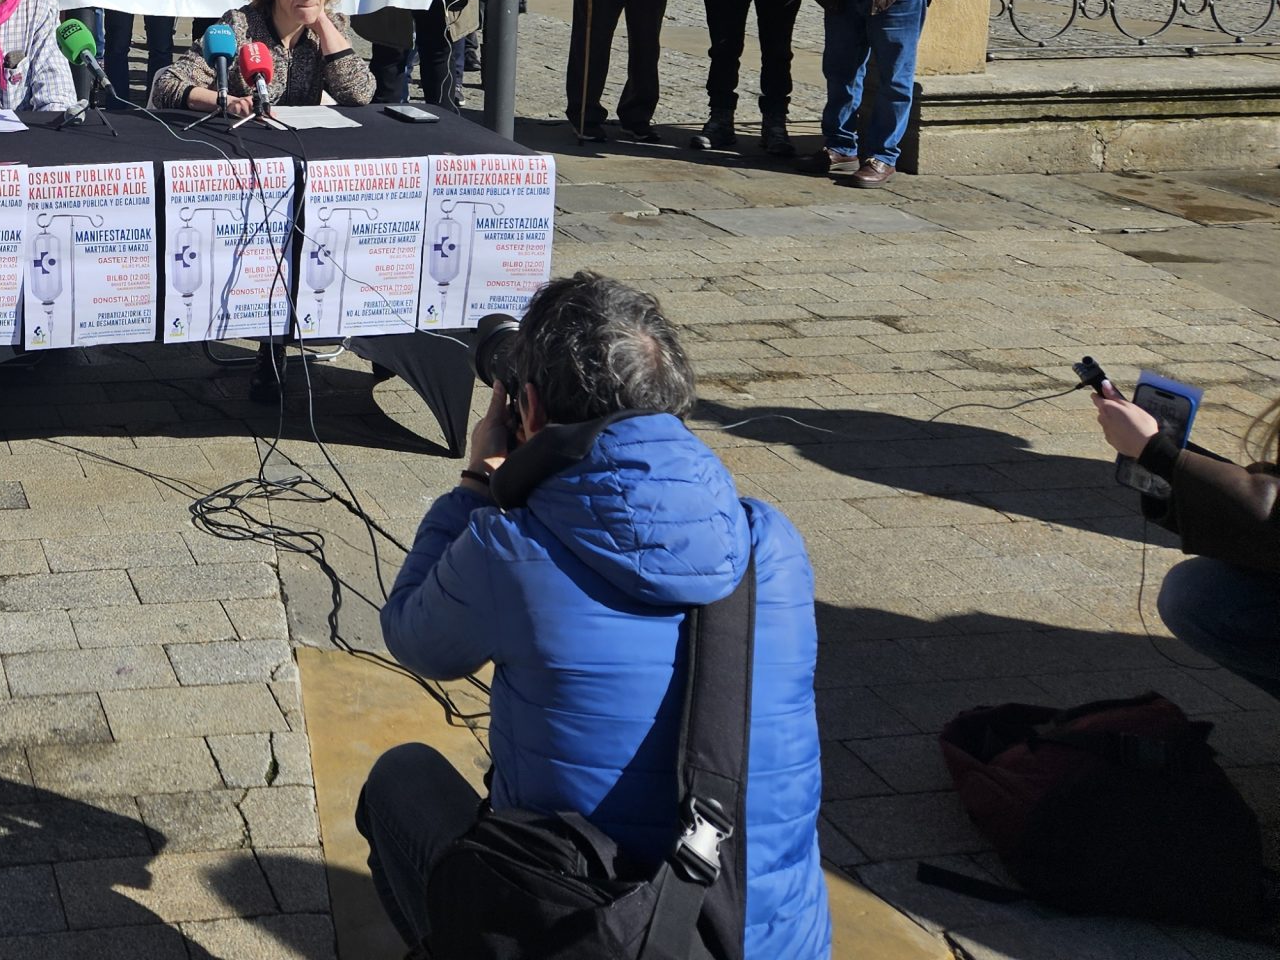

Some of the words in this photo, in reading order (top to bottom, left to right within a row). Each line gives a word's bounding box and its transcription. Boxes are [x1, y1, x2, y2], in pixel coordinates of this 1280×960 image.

[172, 165, 212, 178] OSASUN
[267, 162, 285, 174] ETA
[310, 165, 350, 178] OSASUN
[355, 163, 397, 176] PUBLIKO
[403, 162, 420, 174] ETA
[436, 159, 476, 171] OSASUN
[482, 159, 523, 171] PUBLIKO
[530, 159, 547, 170] ETA
[1, 170, 19, 182] ETA
[29, 171, 70, 185] OSASUN
[76, 168, 120, 182] PUBLIKO
[126, 167, 144, 180] ETA
[264, 176, 287, 188] ALDE
[436, 173, 521, 185] KALITATEZKOAREN
[525, 173, 548, 184] ALDE
[311, 178, 394, 192] KALITATEZKOAREN
[399, 177, 421, 188] ALDE
[29, 184, 118, 200] KALITATEZKOAREN
[123, 182, 147, 195] ALDE
[399, 191, 422, 199] CALIDAD
[125, 197, 150, 205] CALIDAD
[171, 196, 181, 204] POR
[184, 195, 195, 203] UNA
[198, 194, 222, 202] SANIDAD
[352, 221, 420, 235] MANIFESTAZIOAK
[477, 218, 549, 229] MANIFESTAZIOAK
[76, 228, 151, 242] MANIFESTAZIOAK
[257, 237, 264, 245] 16
[85, 245, 116, 253] MARTXOAK
[118, 244, 126, 252] 16
[128, 244, 148, 252] MARZO
